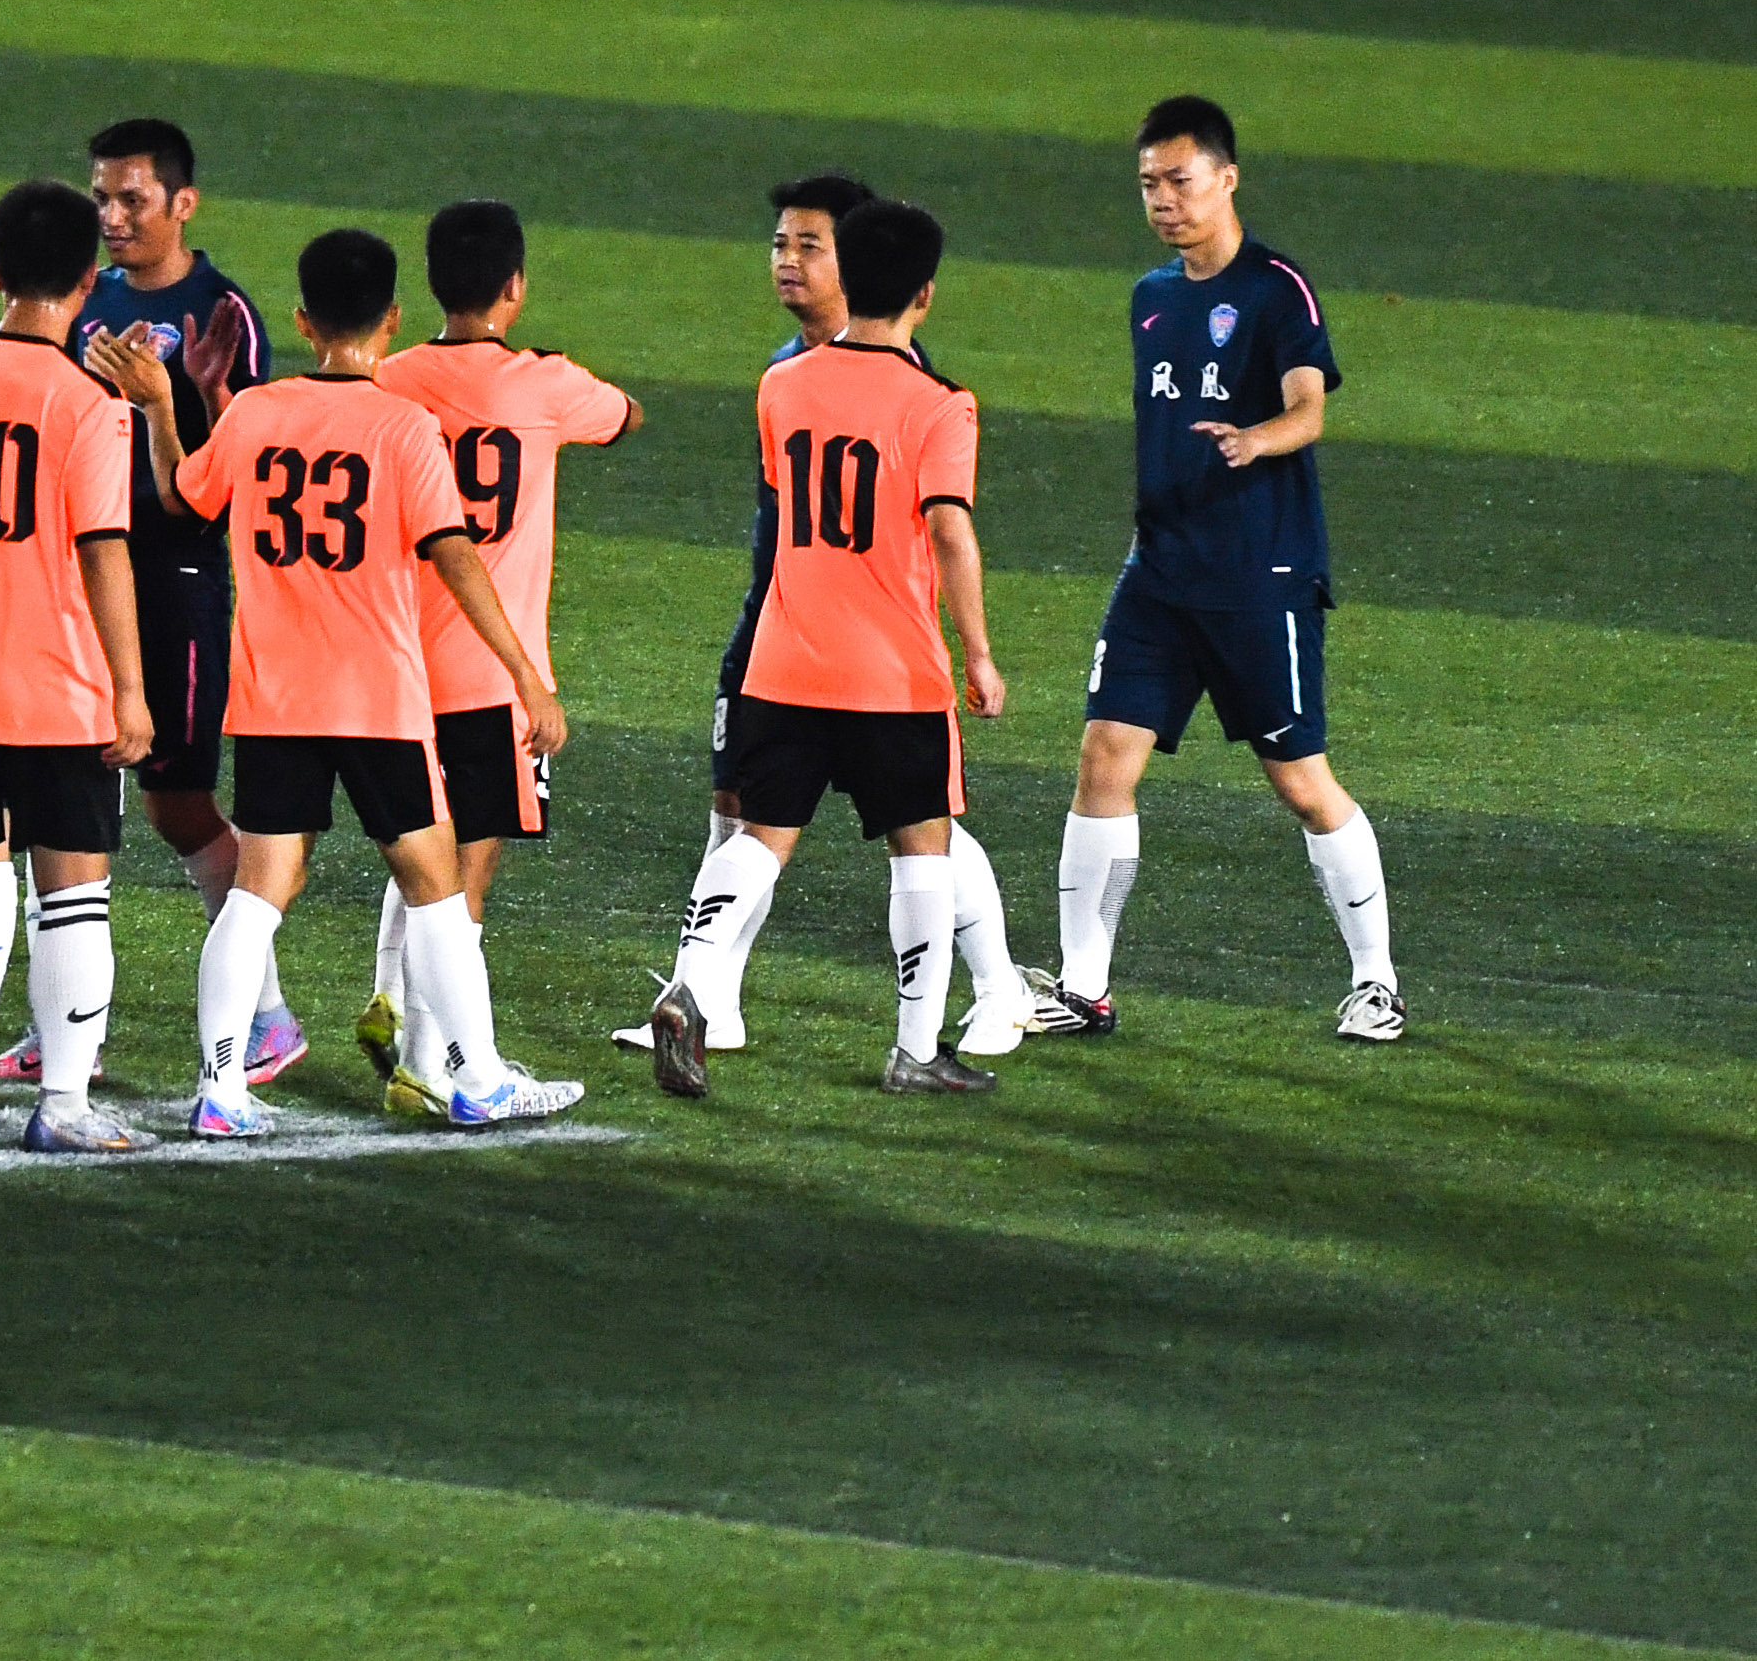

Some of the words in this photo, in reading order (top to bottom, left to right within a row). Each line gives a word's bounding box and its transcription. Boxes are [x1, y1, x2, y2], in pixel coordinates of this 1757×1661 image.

[254, 445, 371, 573] 33
[444, 426, 522, 545] 9
[784, 428, 881, 555] 10
